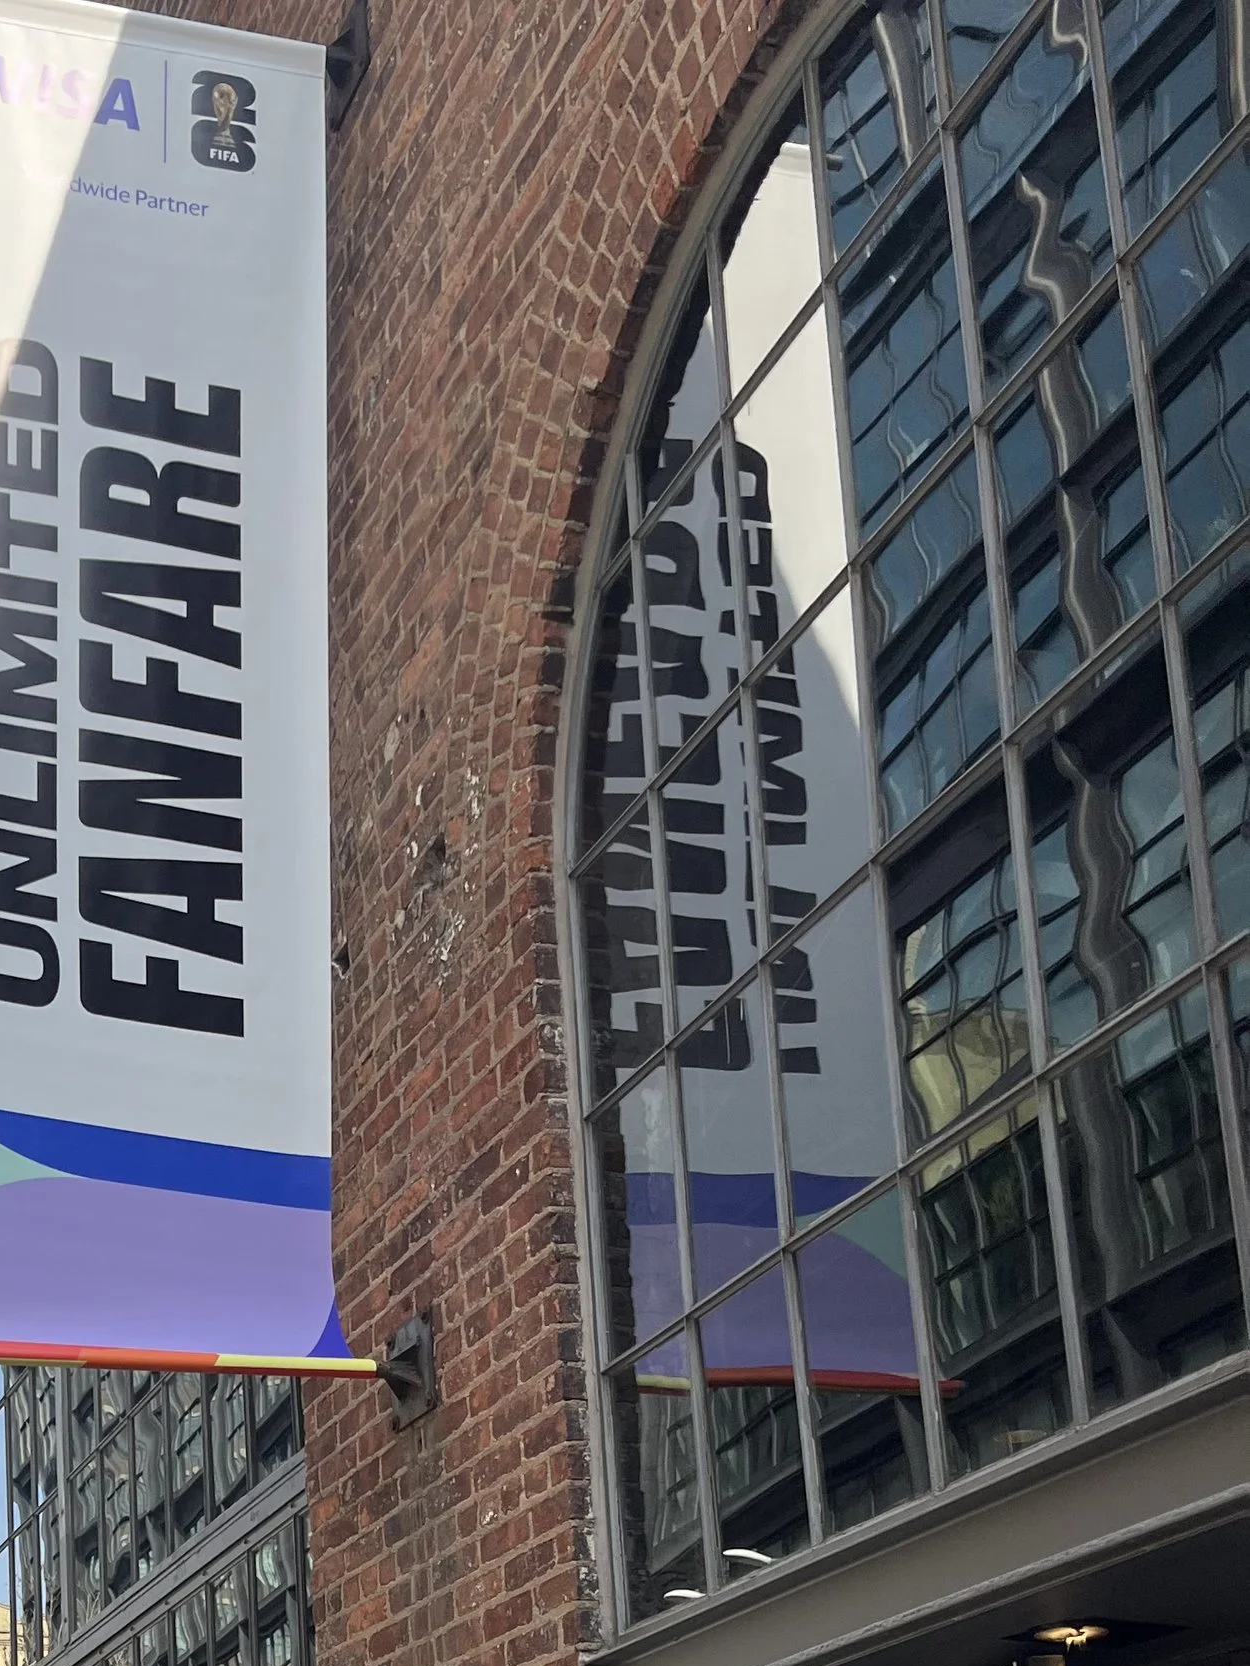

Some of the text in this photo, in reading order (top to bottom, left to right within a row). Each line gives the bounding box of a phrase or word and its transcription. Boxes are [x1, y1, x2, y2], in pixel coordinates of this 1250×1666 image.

[209, 147, 239, 164] FIFA
[134, 188, 209, 218] Partner
[78, 355, 244, 1038] FANFARE
